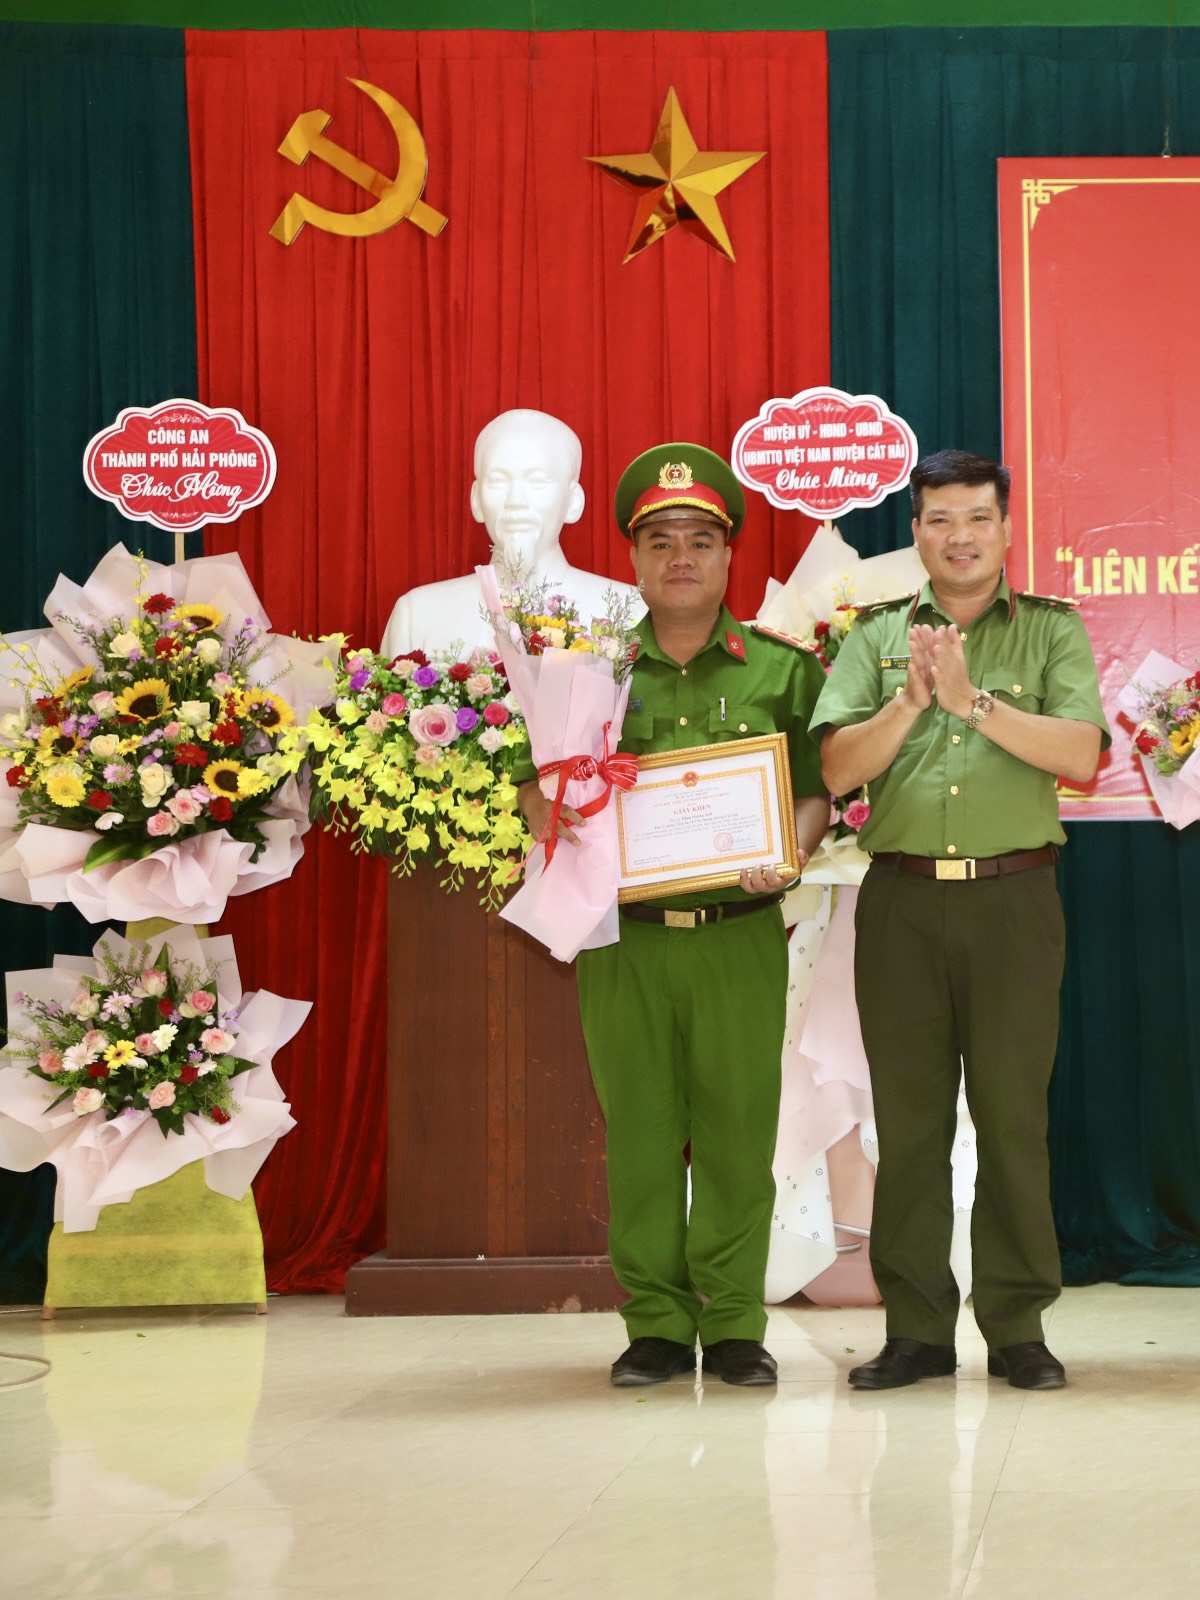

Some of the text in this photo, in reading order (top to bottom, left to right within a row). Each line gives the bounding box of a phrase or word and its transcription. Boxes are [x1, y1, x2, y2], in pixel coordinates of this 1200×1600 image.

[148, 428, 209, 445] CÔNG AN
[764, 423, 796, 444] HUYỆN
[855, 421, 882, 436] UBND
[101, 448, 257, 467] THÀNH PHỐ HẢI PHÒNG
[744, 439, 905, 466] UBMTTQ VIỆT NAM HUYỆN CÁT HẢI
[121, 471, 242, 507] Chúc Mừng
[776, 466, 879, 491] Chúc Mừng
